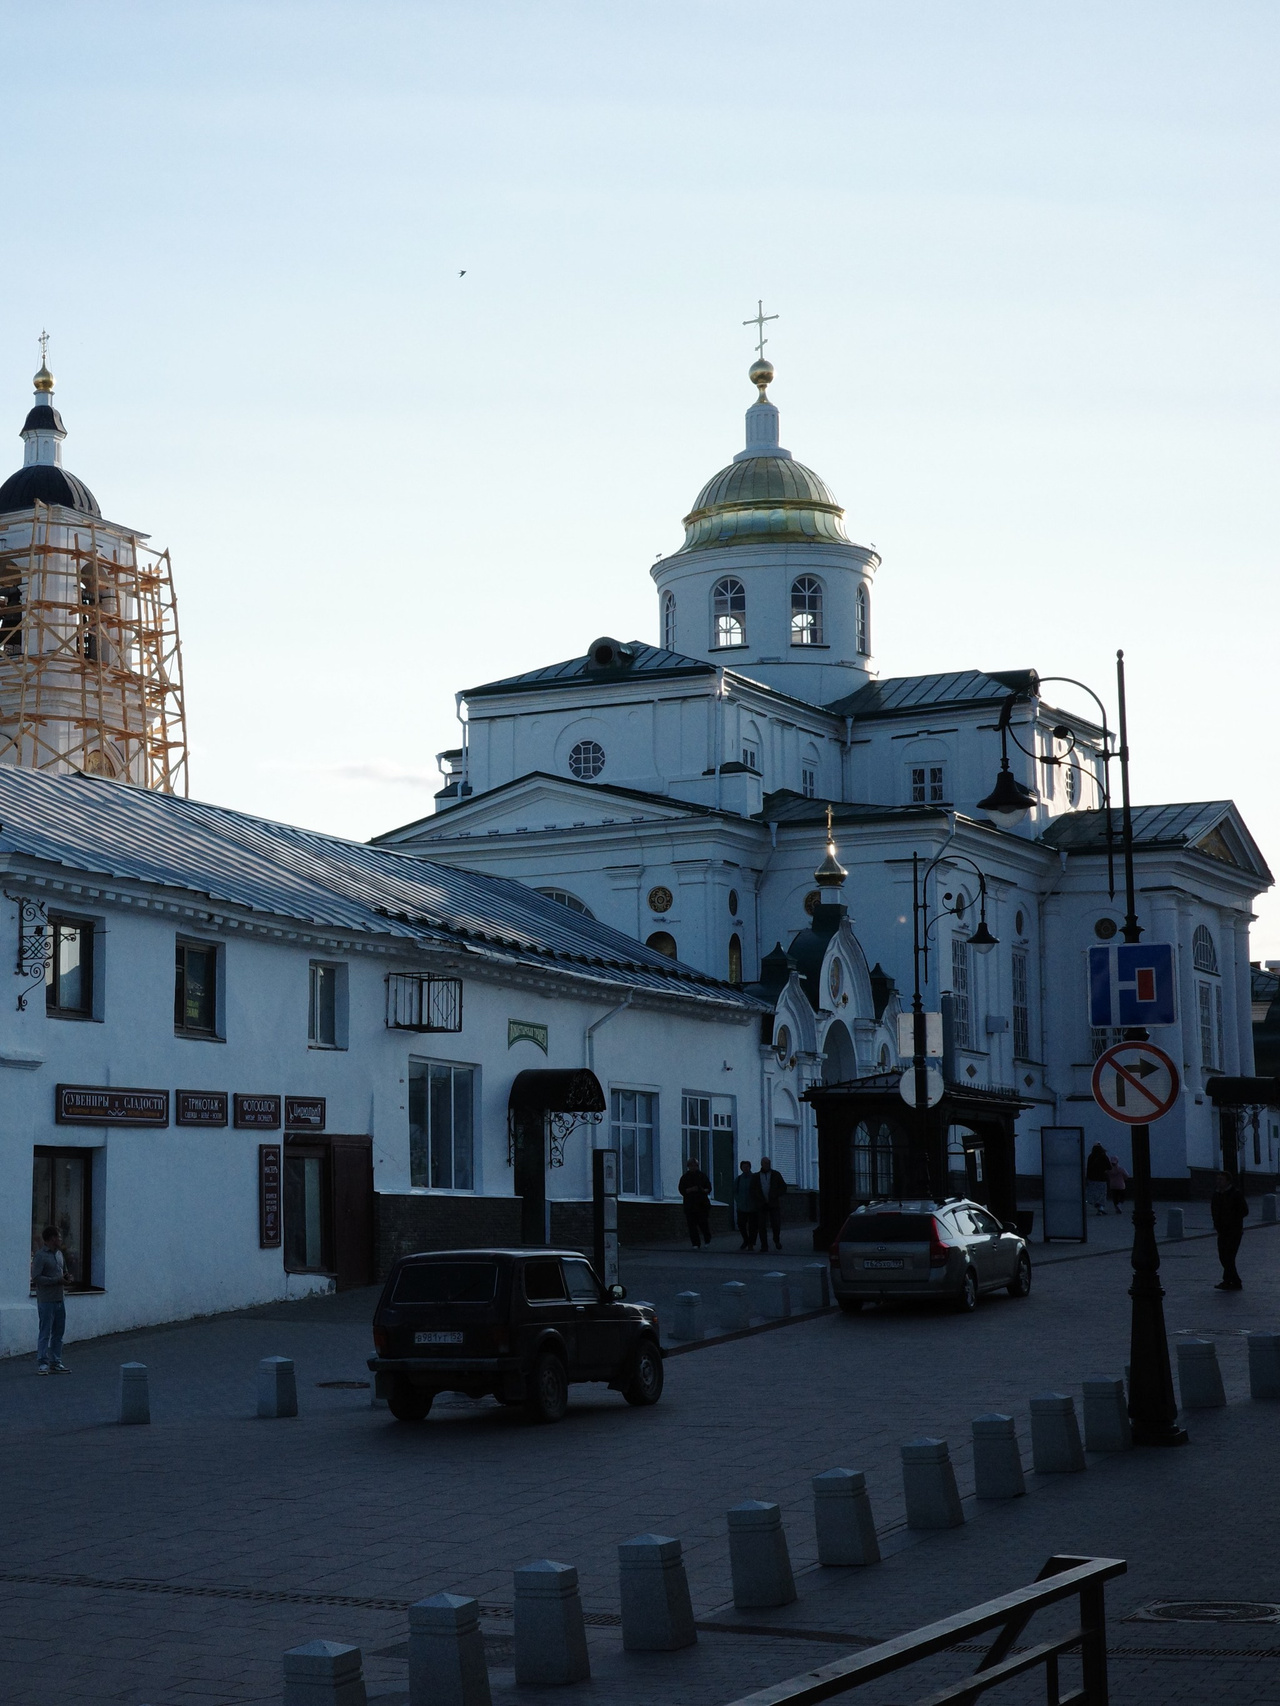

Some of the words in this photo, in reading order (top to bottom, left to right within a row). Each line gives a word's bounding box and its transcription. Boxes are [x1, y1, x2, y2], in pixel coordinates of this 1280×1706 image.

[65, 1093, 109, 1108] СУВЕНИРЫ
[124, 1097, 163, 1111] СЛАДОСТИ
[188, 1098, 219, 1111] ТРИКОТАЖ
[243, 1101, 275, 1112] ФОТОСАЛОН
